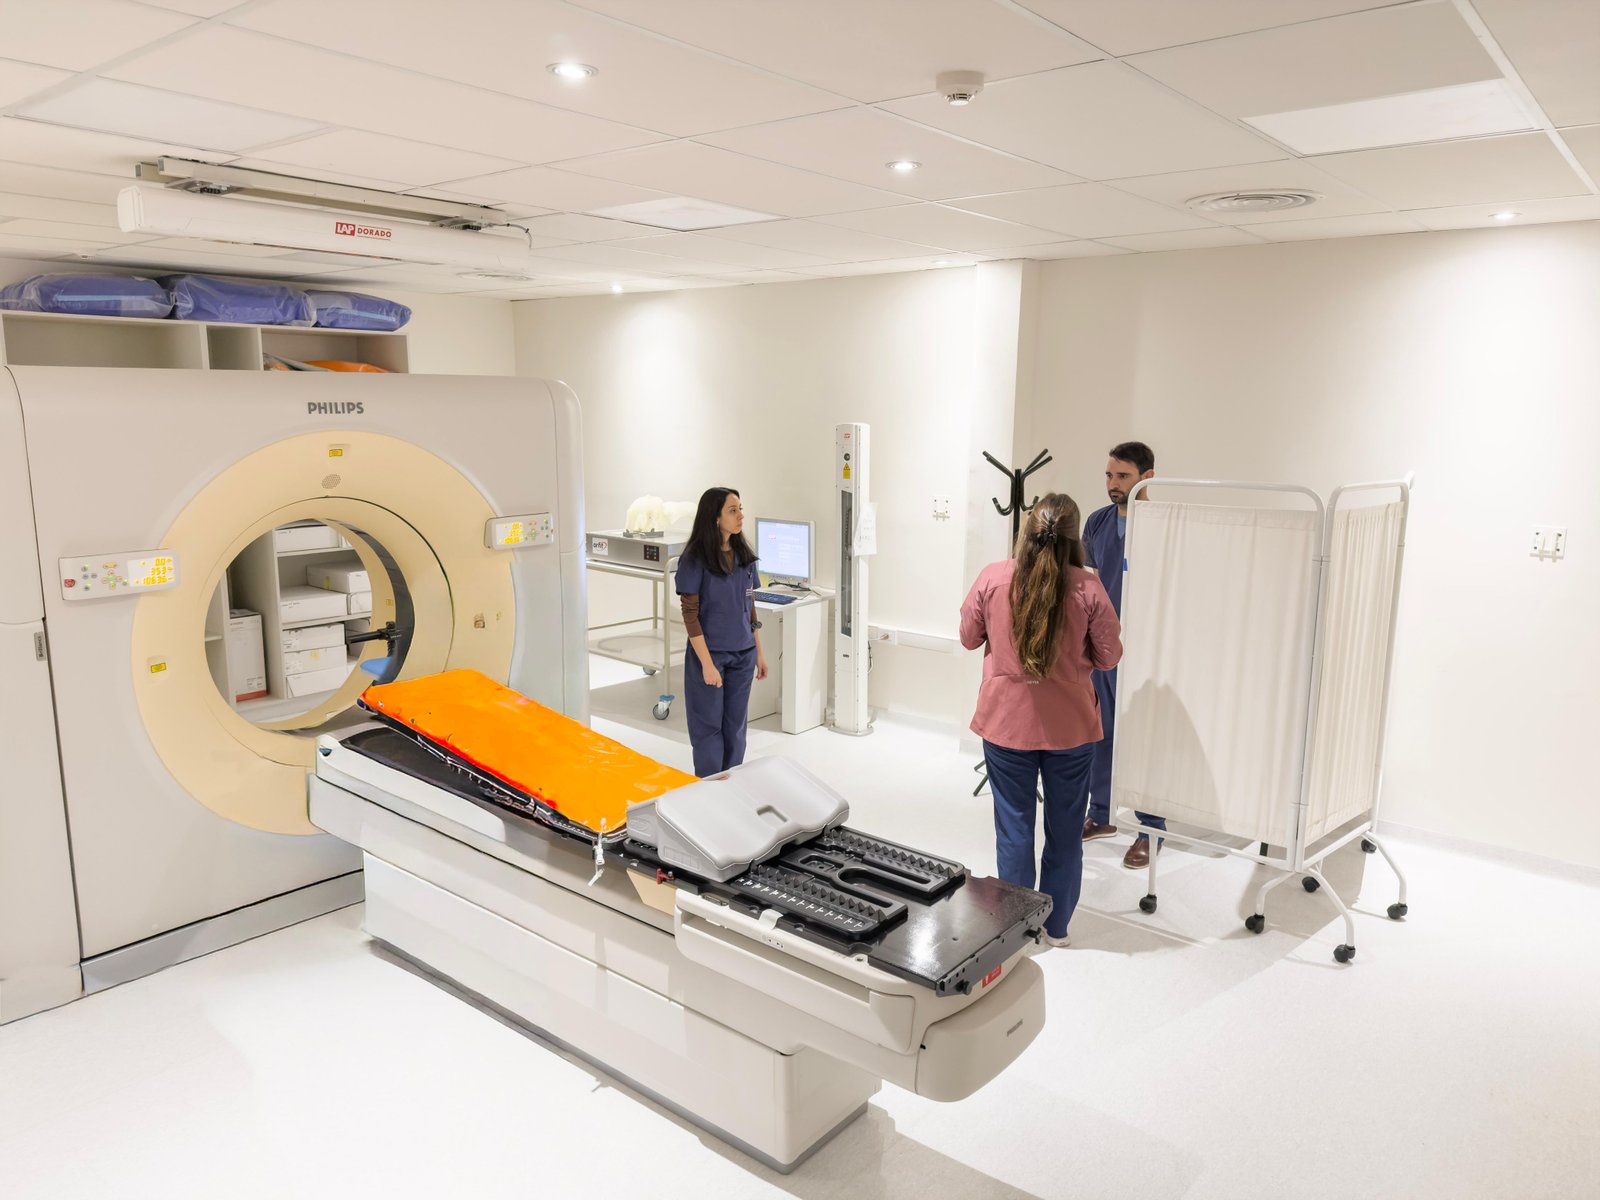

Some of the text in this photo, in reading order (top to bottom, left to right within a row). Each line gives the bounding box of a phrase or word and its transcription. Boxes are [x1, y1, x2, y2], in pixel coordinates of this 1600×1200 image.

[336, 223, 392, 238] LAP DORADO
[307, 401, 364, 414] PHILIPS
